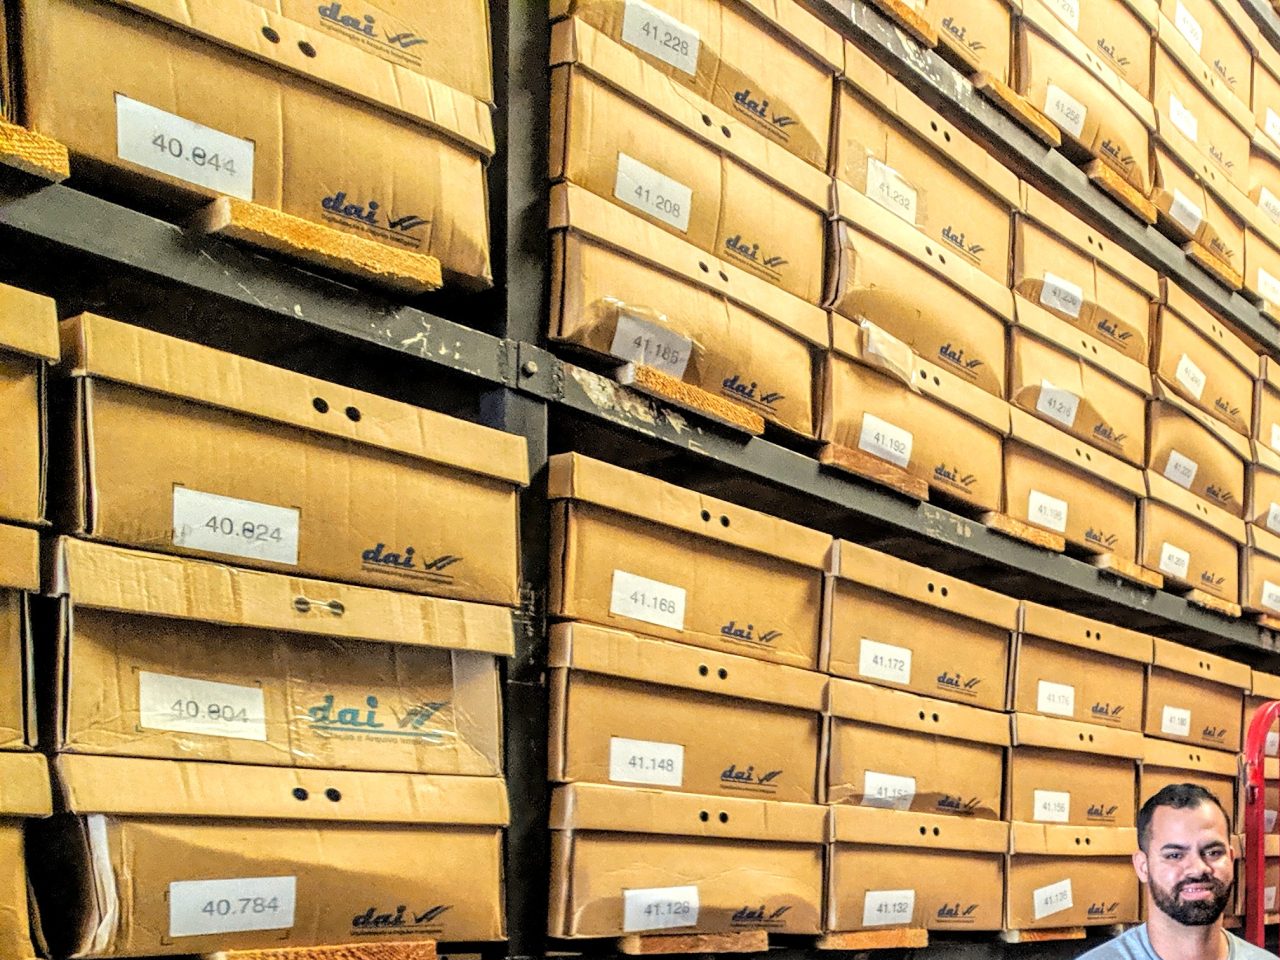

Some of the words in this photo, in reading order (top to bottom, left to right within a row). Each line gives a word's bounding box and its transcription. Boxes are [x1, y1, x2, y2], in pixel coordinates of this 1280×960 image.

[318, 2, 378, 37] dai
[942, 17, 966, 41] dai
[642, 21, 689, 57] 41.228
[1097, 38, 1116, 60] dai
[734, 89, 770, 118] dai
[151, 131, 237, 177] 40.844
[1102, 138, 1122, 157] dai
[321, 191, 379, 224] dai
[634, 185, 681, 218] 41.208
[725, 234, 760, 260] dai
[942, 226, 965, 249] dai
[1097, 320, 1118, 337] dai
[939, 344, 964, 364] dai
[722, 375, 756, 398] dai
[1215, 398, 1229, 412] dai
[1094, 424, 1112, 438] dai
[874, 432, 906, 455] 41.192
[934, 464, 958, 482] dai
[1206, 484, 1221, 499] dai
[205, 514, 283, 544] 40.824
[1084, 527, 1104, 541] dai
[362, 542, 416, 569] dai
[1201, 571, 1215, 584] dai
[629, 590, 676, 614] 41.168
[720, 621, 754, 641] dai
[872, 654, 905, 672] 41.172
[936, 672, 960, 688] dai
[170, 698, 249, 723] 40.804
[308, 695, 384, 728] dai
[1092, 702, 1109, 714] dai
[1202, 726, 1217, 737] dai
[628, 755, 674, 772] 41.148
[720, 764, 754, 781] dai
[938, 796, 962, 809] dai
[1087, 804, 1104, 816] dai
[202, 896, 280, 916] 40.784
[352, 905, 406, 926] dai
[642, 900, 690, 916] 41.128
[732, 905, 766, 920] dai
[876, 902, 908, 914] 41.132
[937, 903, 960, 918] dai
[1087, 902, 1105, 914] dai
